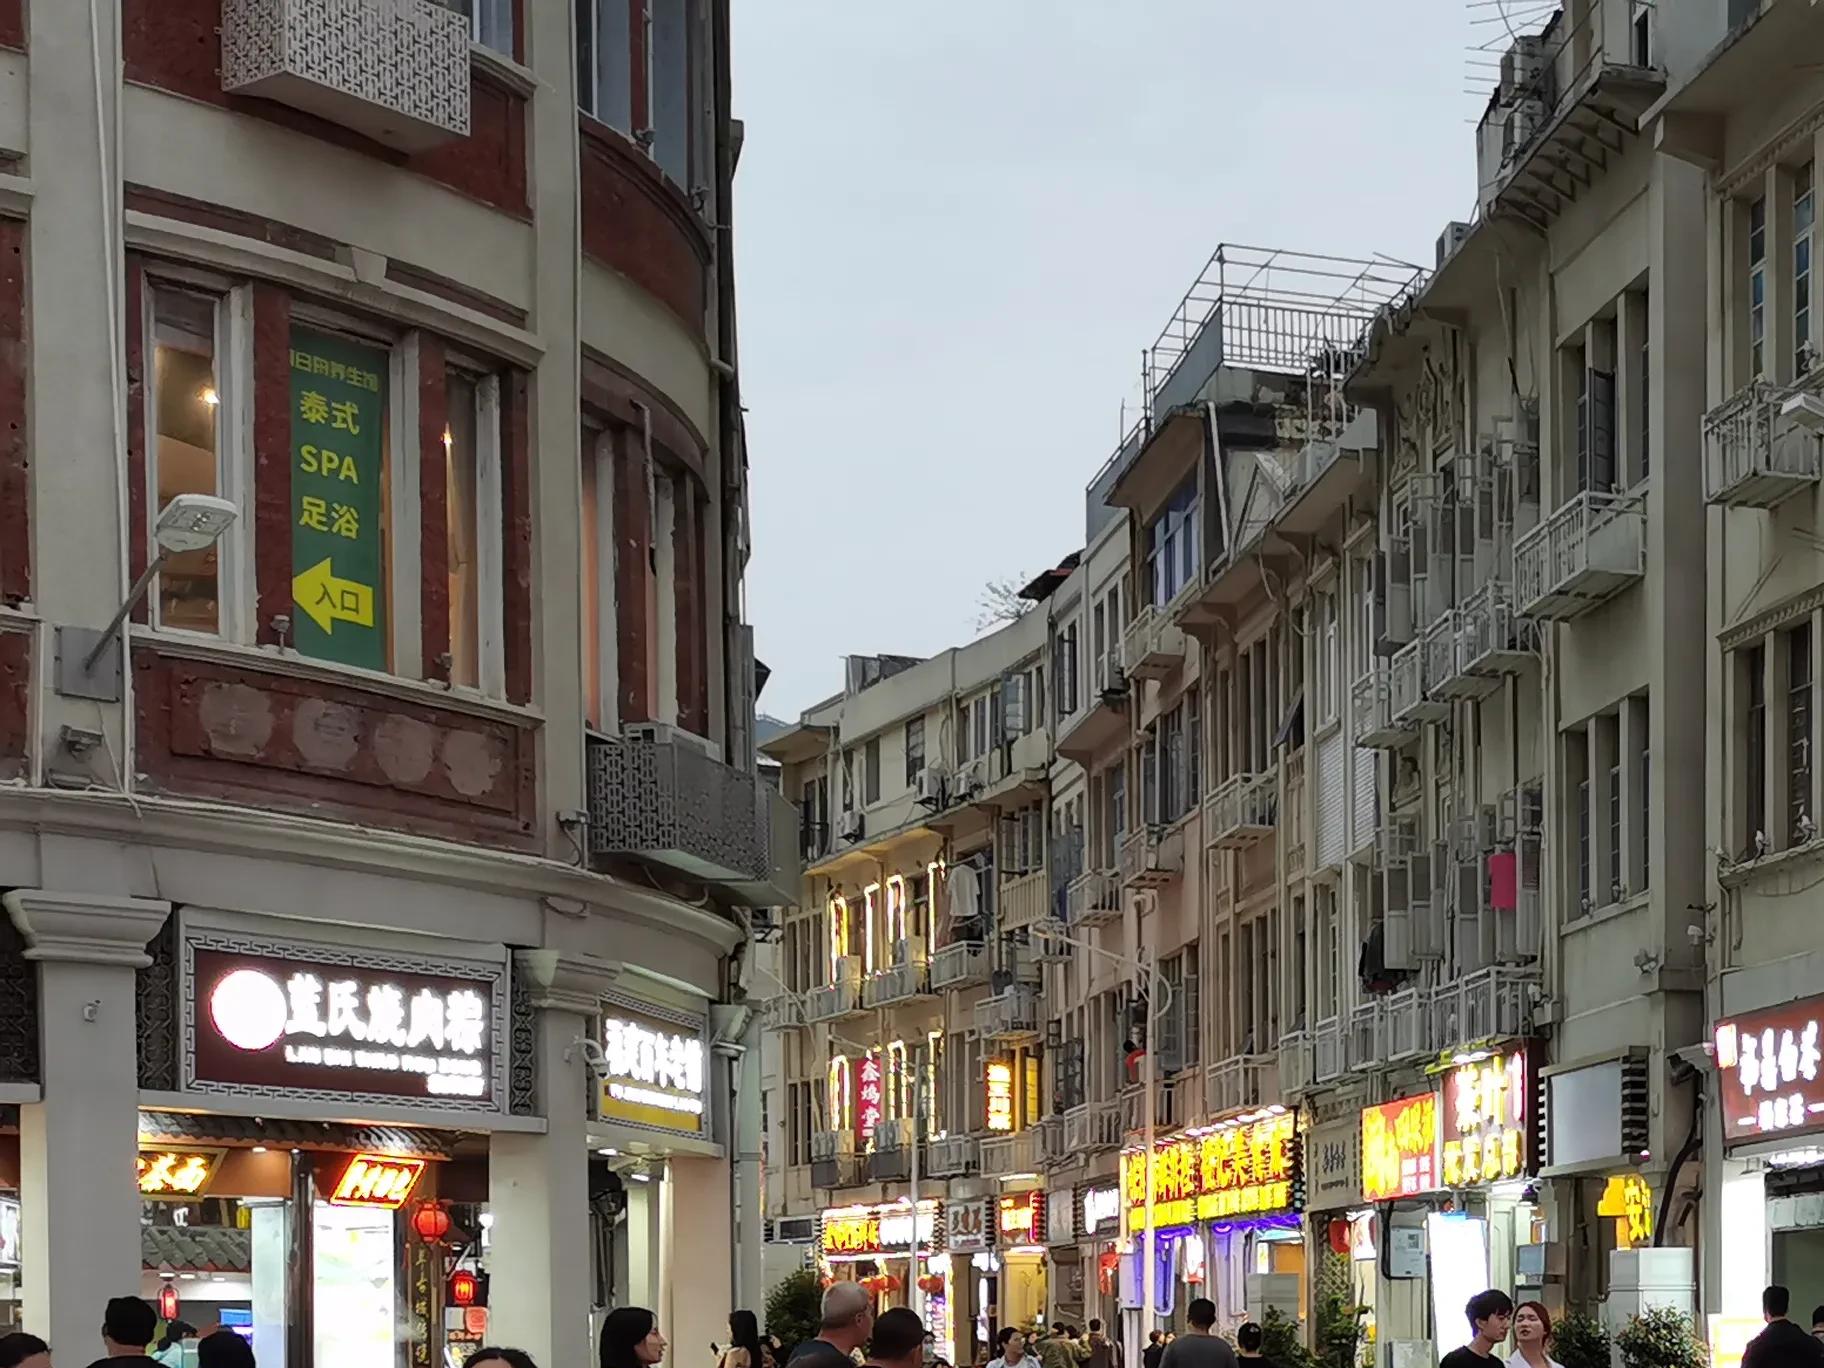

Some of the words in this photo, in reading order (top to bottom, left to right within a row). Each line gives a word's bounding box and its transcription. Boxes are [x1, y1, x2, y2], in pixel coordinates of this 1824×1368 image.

[300, 391, 360, 434] 泰式
[300, 444, 359, 485] SPA
[299, 496, 359, 540] 足浴
[315, 582, 360, 614] 入口
